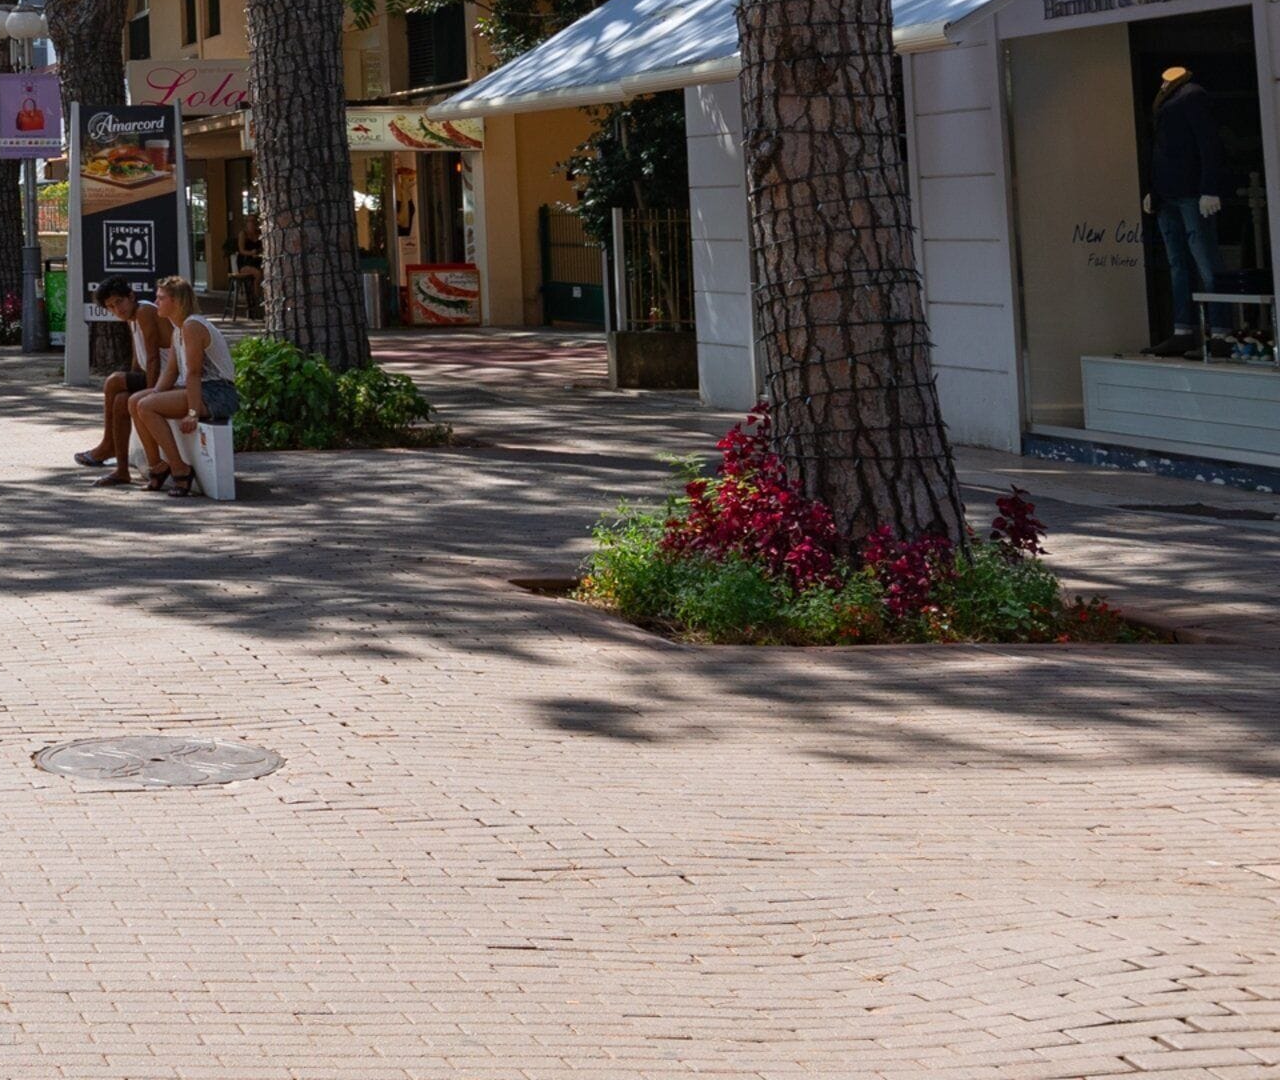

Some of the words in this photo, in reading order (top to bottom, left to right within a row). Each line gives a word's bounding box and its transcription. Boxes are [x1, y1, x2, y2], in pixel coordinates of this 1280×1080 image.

[91, 114, 165, 139] Amarcord
[109, 226, 149, 234] BLOCK
[1072, 222, 1105, 244] New
[110, 236, 148, 260] 60
